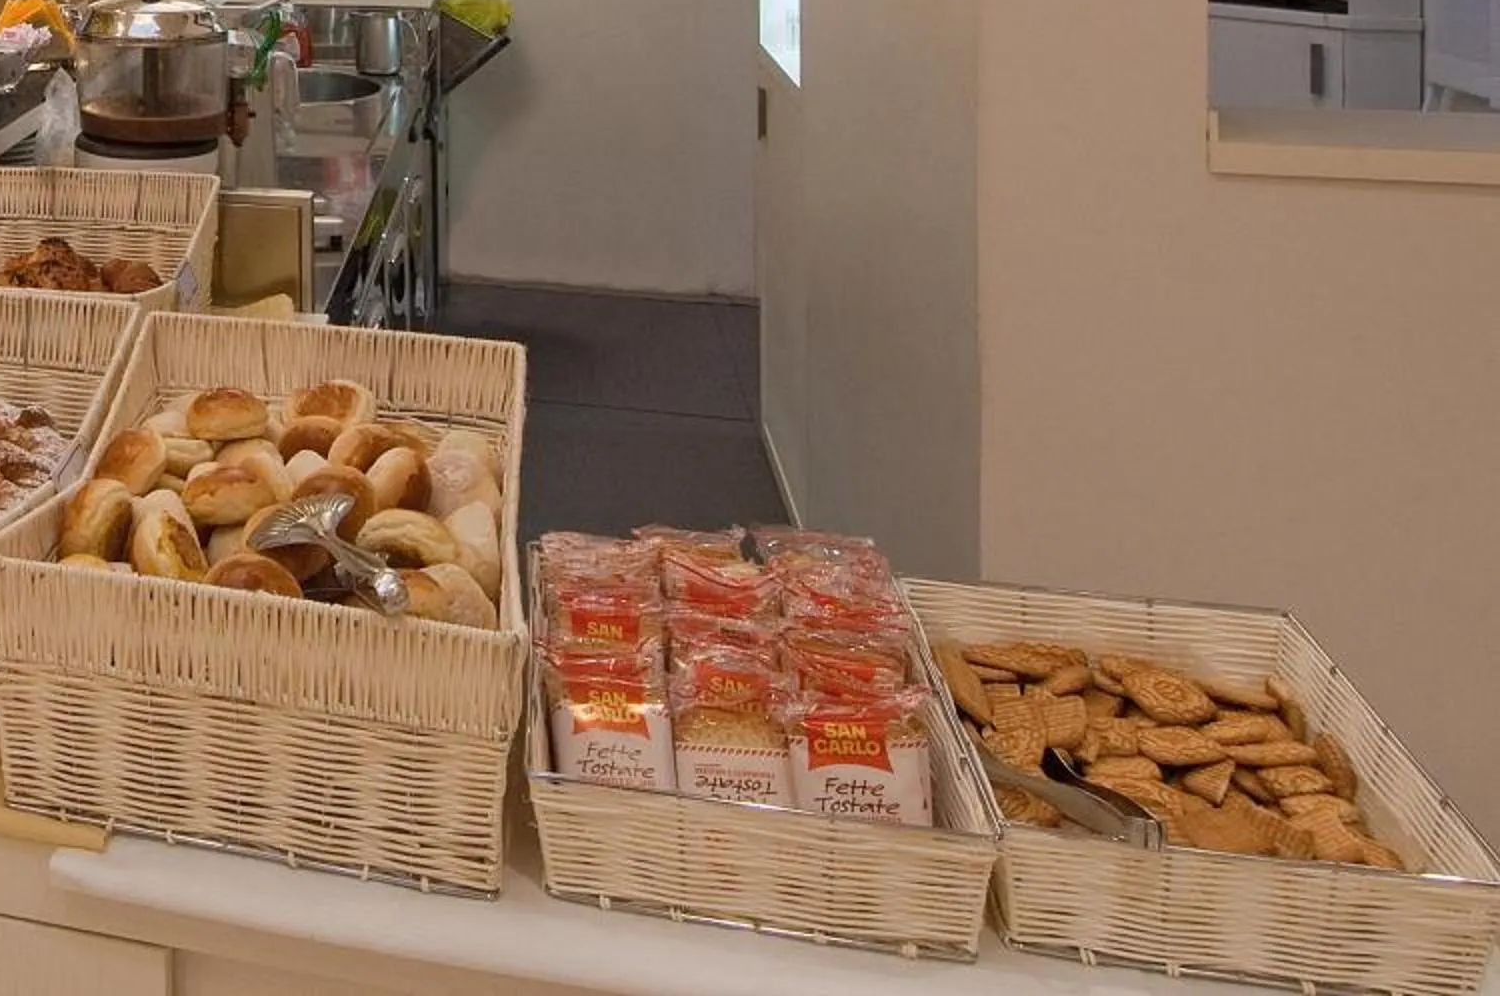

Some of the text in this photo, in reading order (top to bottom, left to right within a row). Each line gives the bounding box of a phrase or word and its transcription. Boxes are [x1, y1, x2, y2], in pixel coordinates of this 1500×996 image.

[587, 621, 623, 639] SAN
[588, 691, 628, 705] SAN
[823, 722, 867, 740] SAN
[586, 741, 643, 761] Fette
[813, 739, 881, 757] CARLO
[576, 759, 656, 779] Tostate
[694, 775, 778, 795] Tostate
[825, 777, 885, 797] Fette
[813, 796, 901, 815] Tostate
